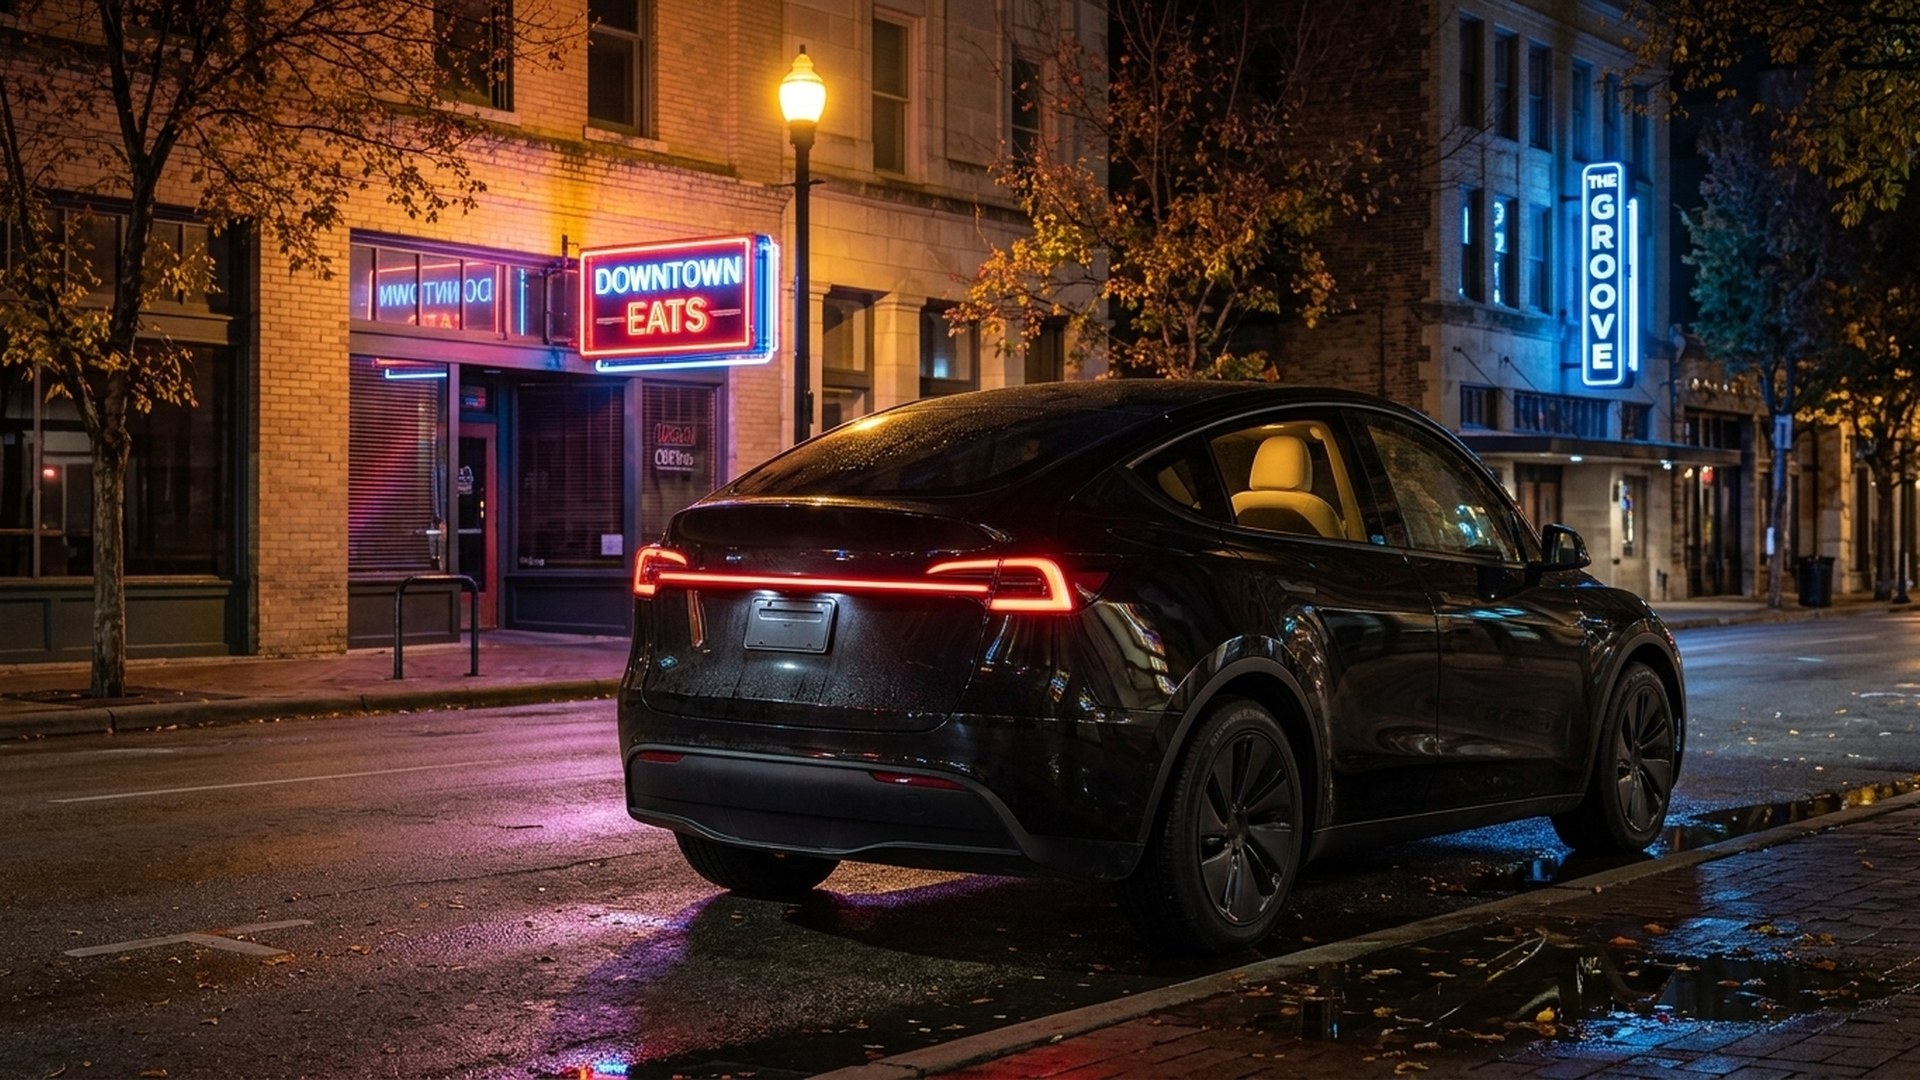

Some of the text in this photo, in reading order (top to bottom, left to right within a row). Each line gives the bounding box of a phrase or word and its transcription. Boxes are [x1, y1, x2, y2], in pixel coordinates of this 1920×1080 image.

[1587, 173, 1617, 189] THE
[595, 256, 742, 295] DOWNTOWN
[1590, 194, 1616, 369] GROOVE
[627, 297, 707, 336] EATS
